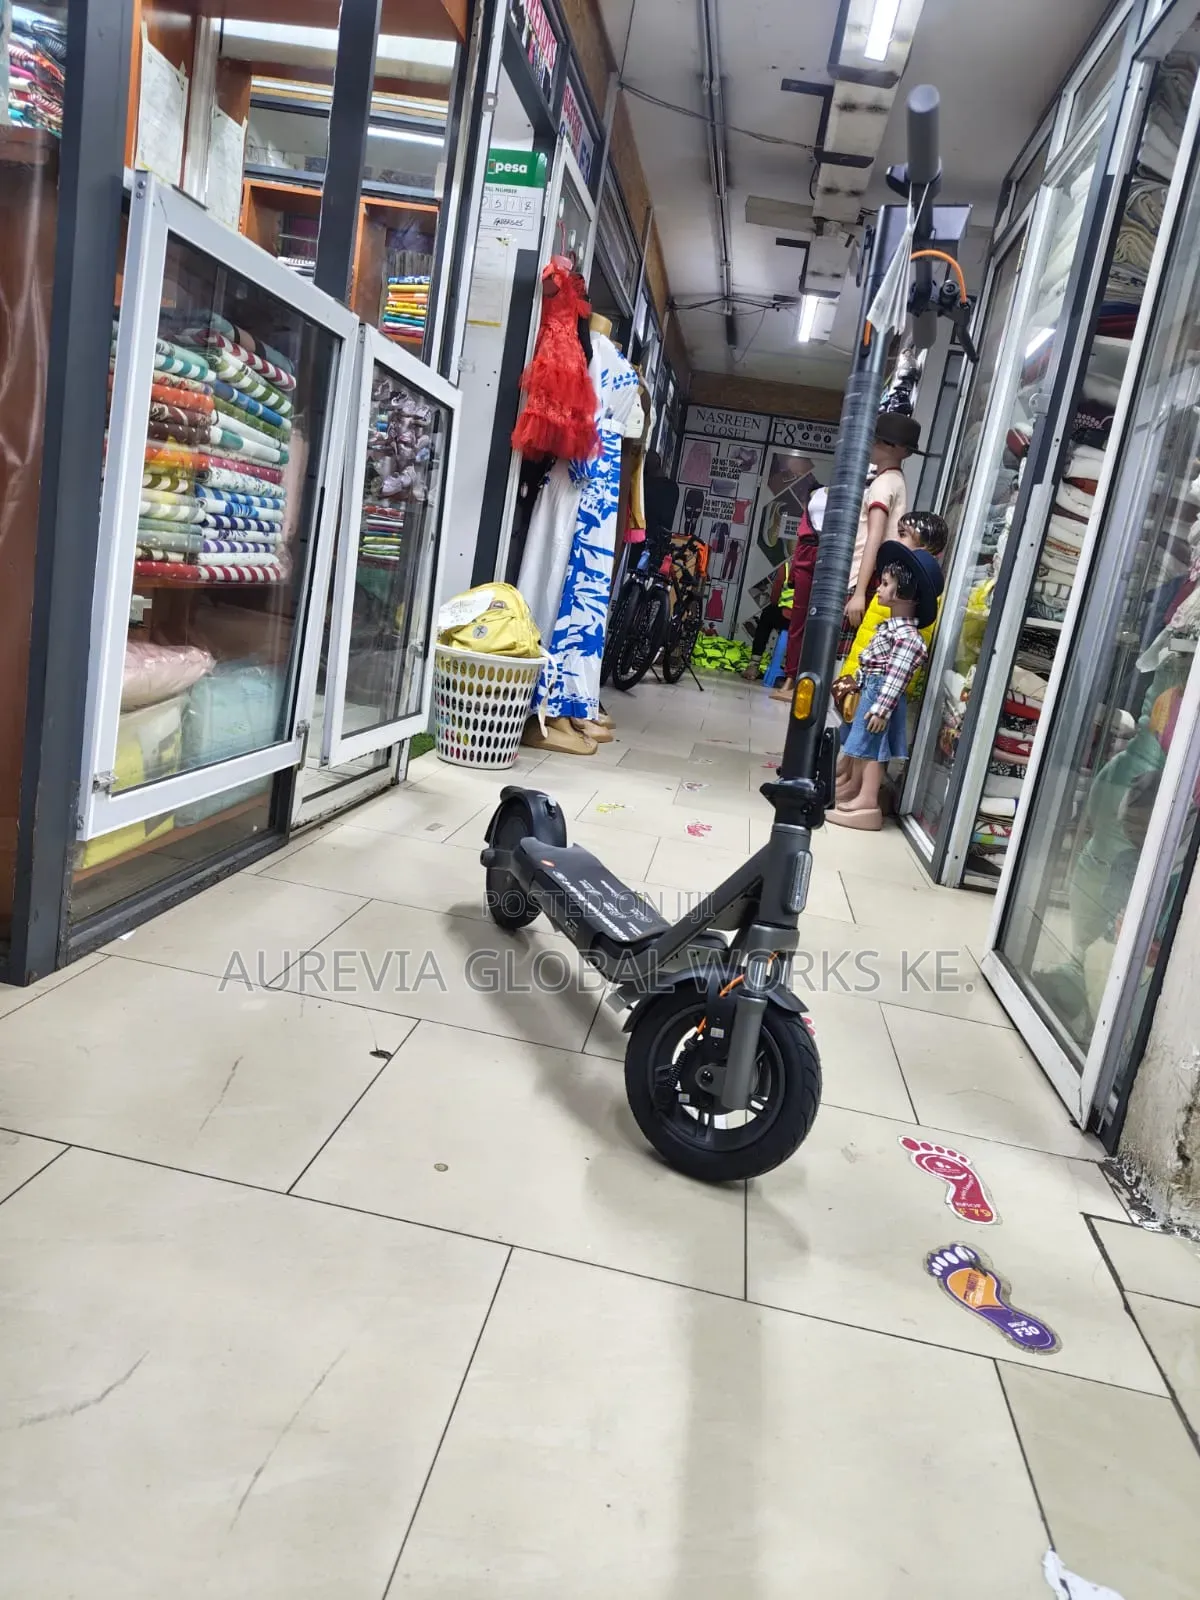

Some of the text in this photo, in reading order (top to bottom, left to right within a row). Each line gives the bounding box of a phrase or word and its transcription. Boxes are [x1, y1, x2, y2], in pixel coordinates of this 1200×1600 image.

[697, 409, 762, 430] NASREEN
[704, 424, 749, 439] CLOSET
[772, 422, 797, 445] F8
